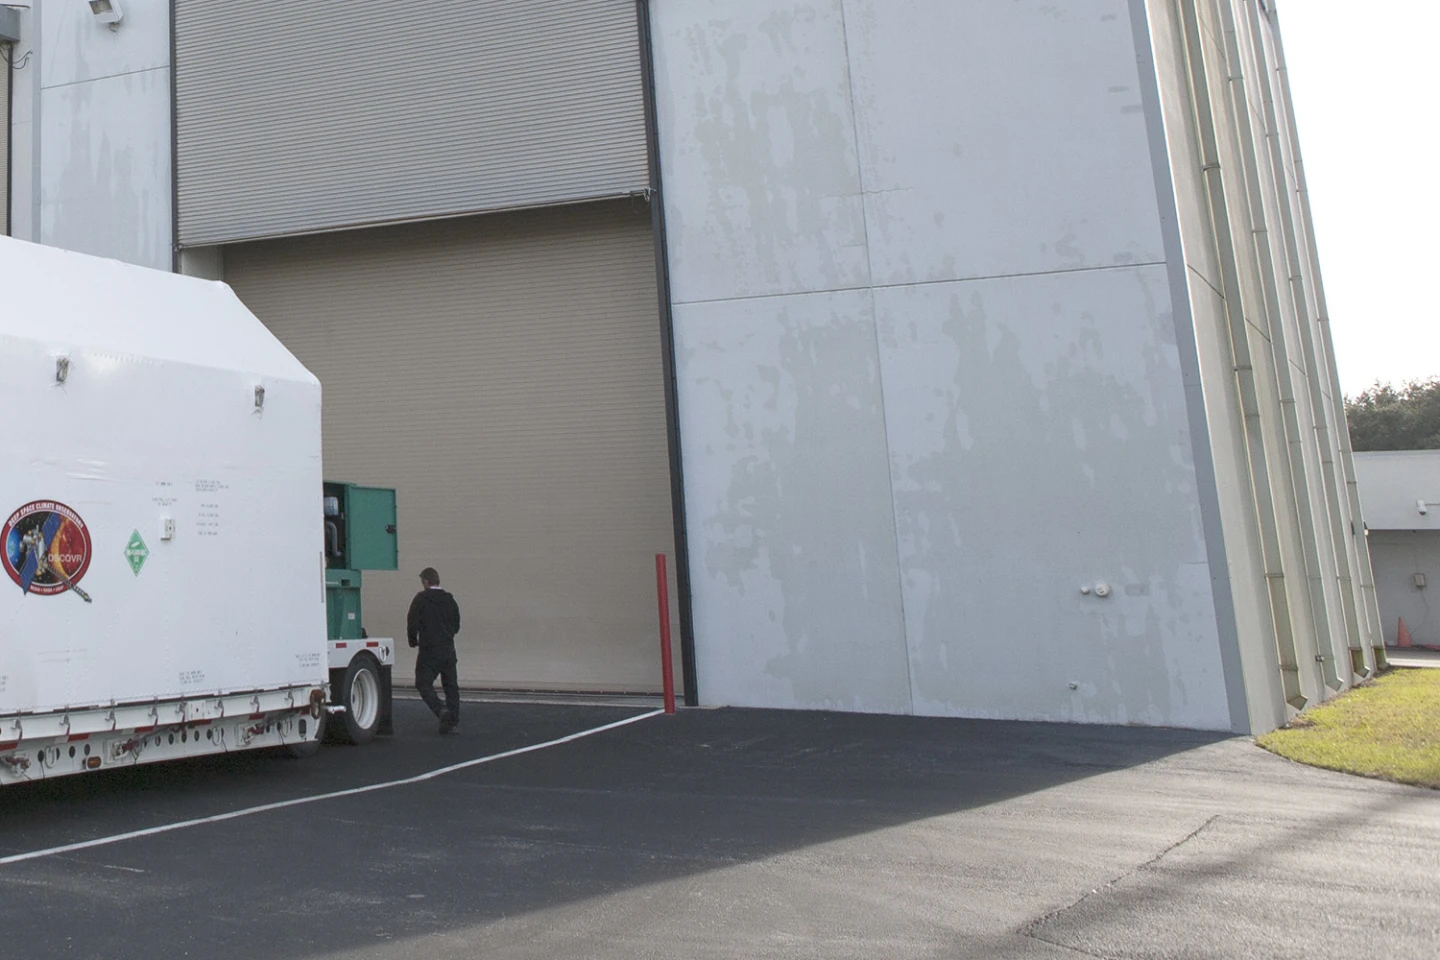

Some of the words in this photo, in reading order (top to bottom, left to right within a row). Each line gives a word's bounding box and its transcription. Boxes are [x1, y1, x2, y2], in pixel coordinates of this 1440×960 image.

[8, 513, 20, 527] DEEP
[20, 504, 35, 515] SPACE
[36, 502, 55, 510] CLIMATE
[55, 503, 84, 528] OBSERVATORY
[48, 554, 82, 563] DSCOVR
